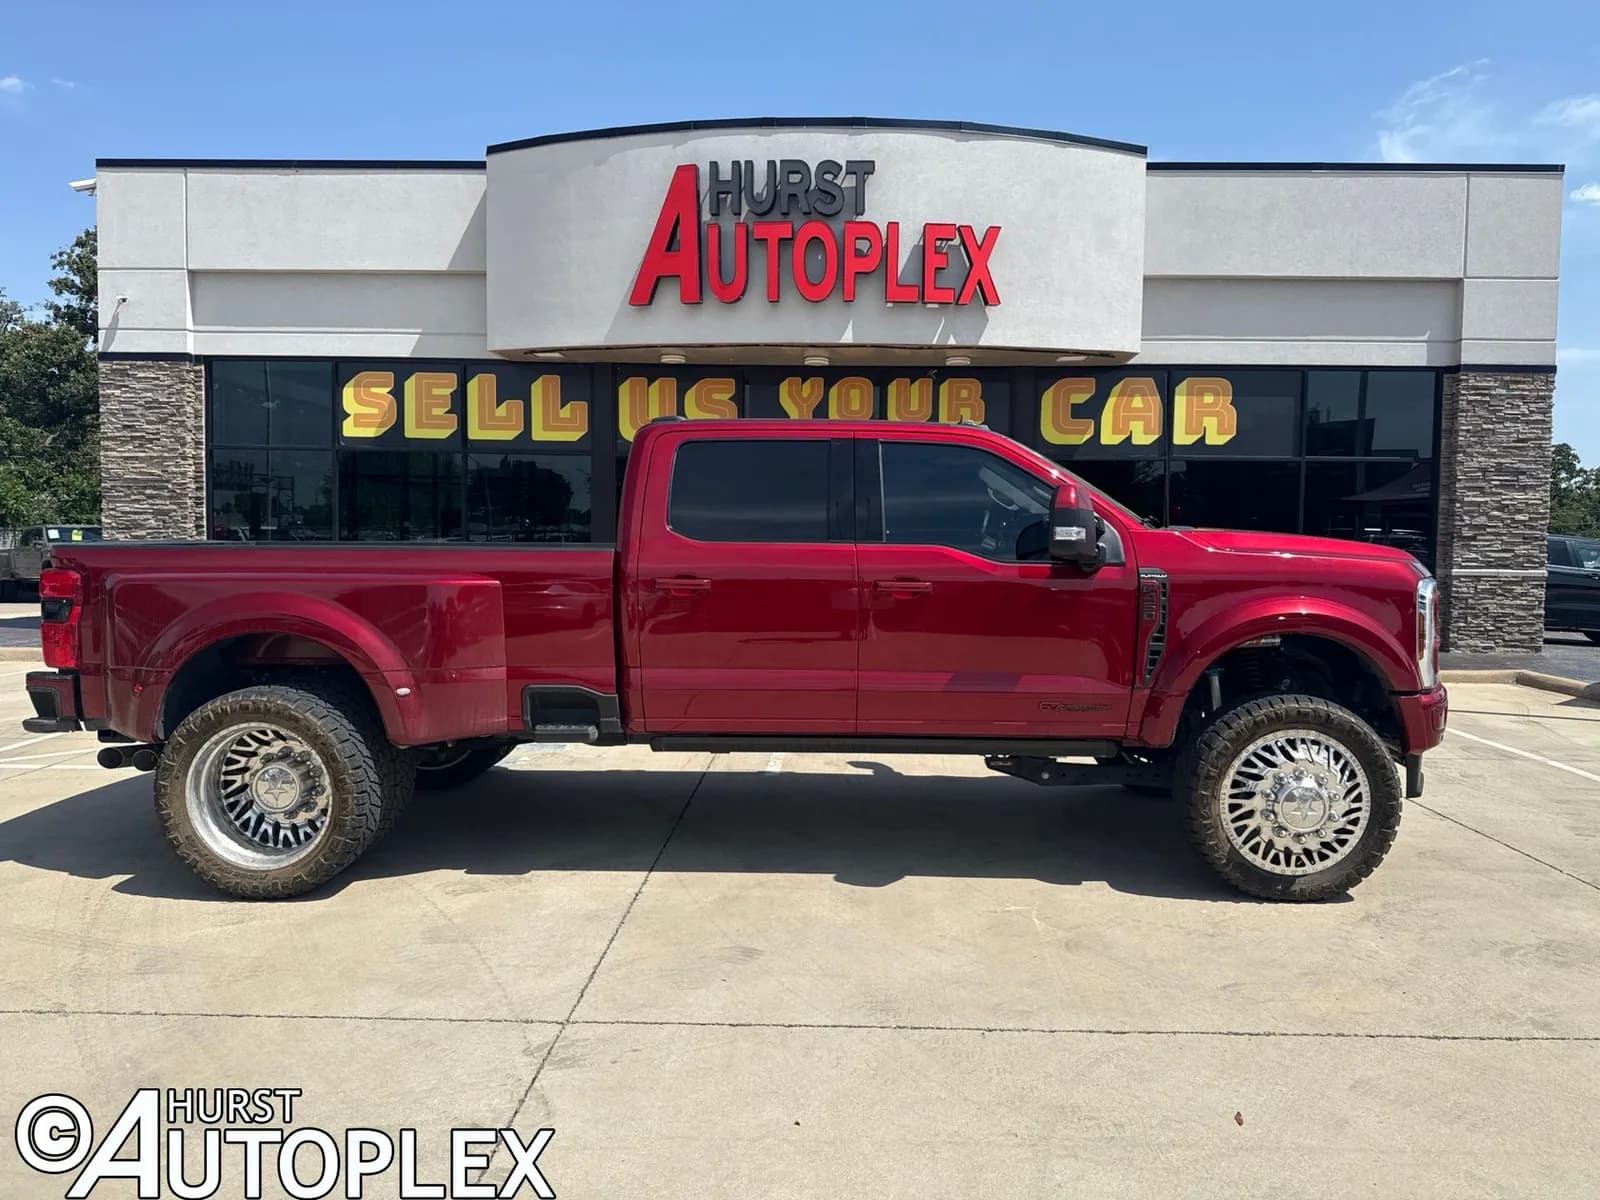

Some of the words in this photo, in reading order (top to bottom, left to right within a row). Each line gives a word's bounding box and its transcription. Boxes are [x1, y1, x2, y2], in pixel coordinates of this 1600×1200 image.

[708, 159, 876, 217] HURST
[628, 163, 1002, 306] AUTOPLEX
[342, 371, 589, 441] SELL
[618, 376, 738, 441] US
[779, 376, 986, 424] YOUR
[1040, 377, 1237, 445] CAR
